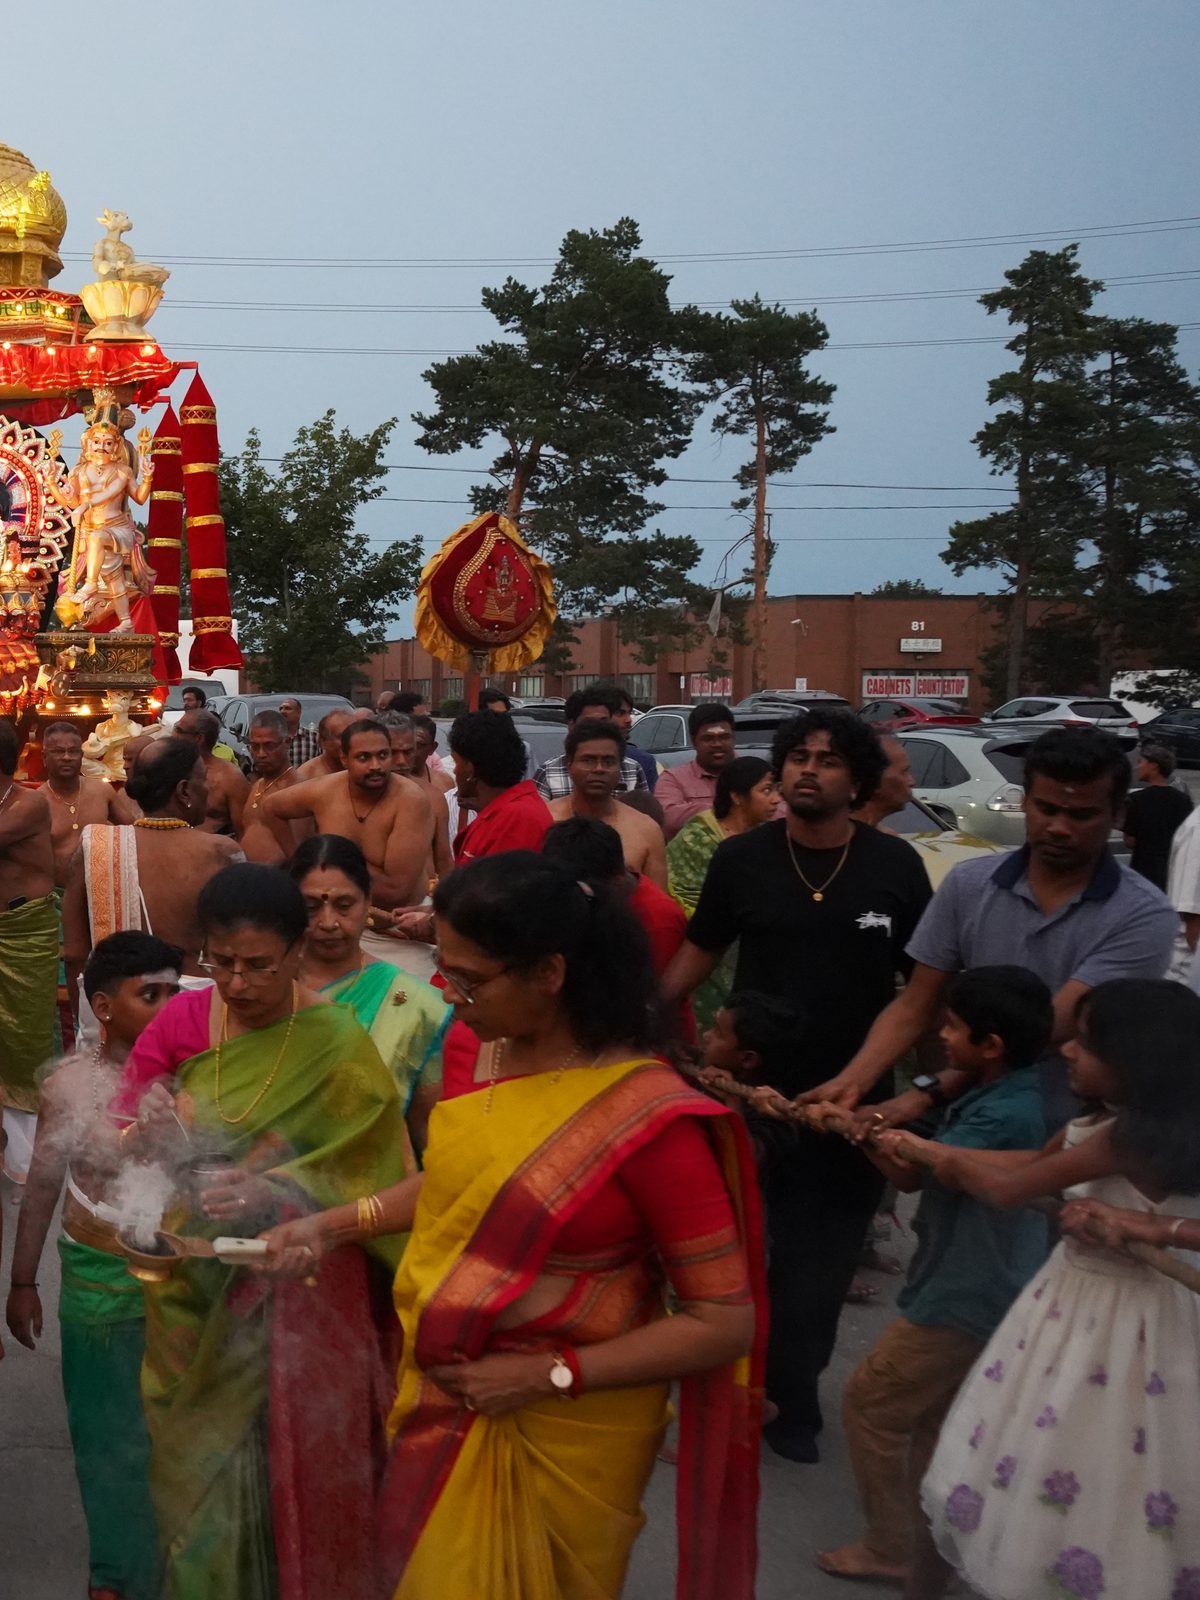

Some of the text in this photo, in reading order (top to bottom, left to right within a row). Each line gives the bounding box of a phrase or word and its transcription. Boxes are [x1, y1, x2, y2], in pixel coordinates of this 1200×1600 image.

[911, 621, 925, 631] 81
[866, 678, 965, 695] CABINETS COUNTERTOP
